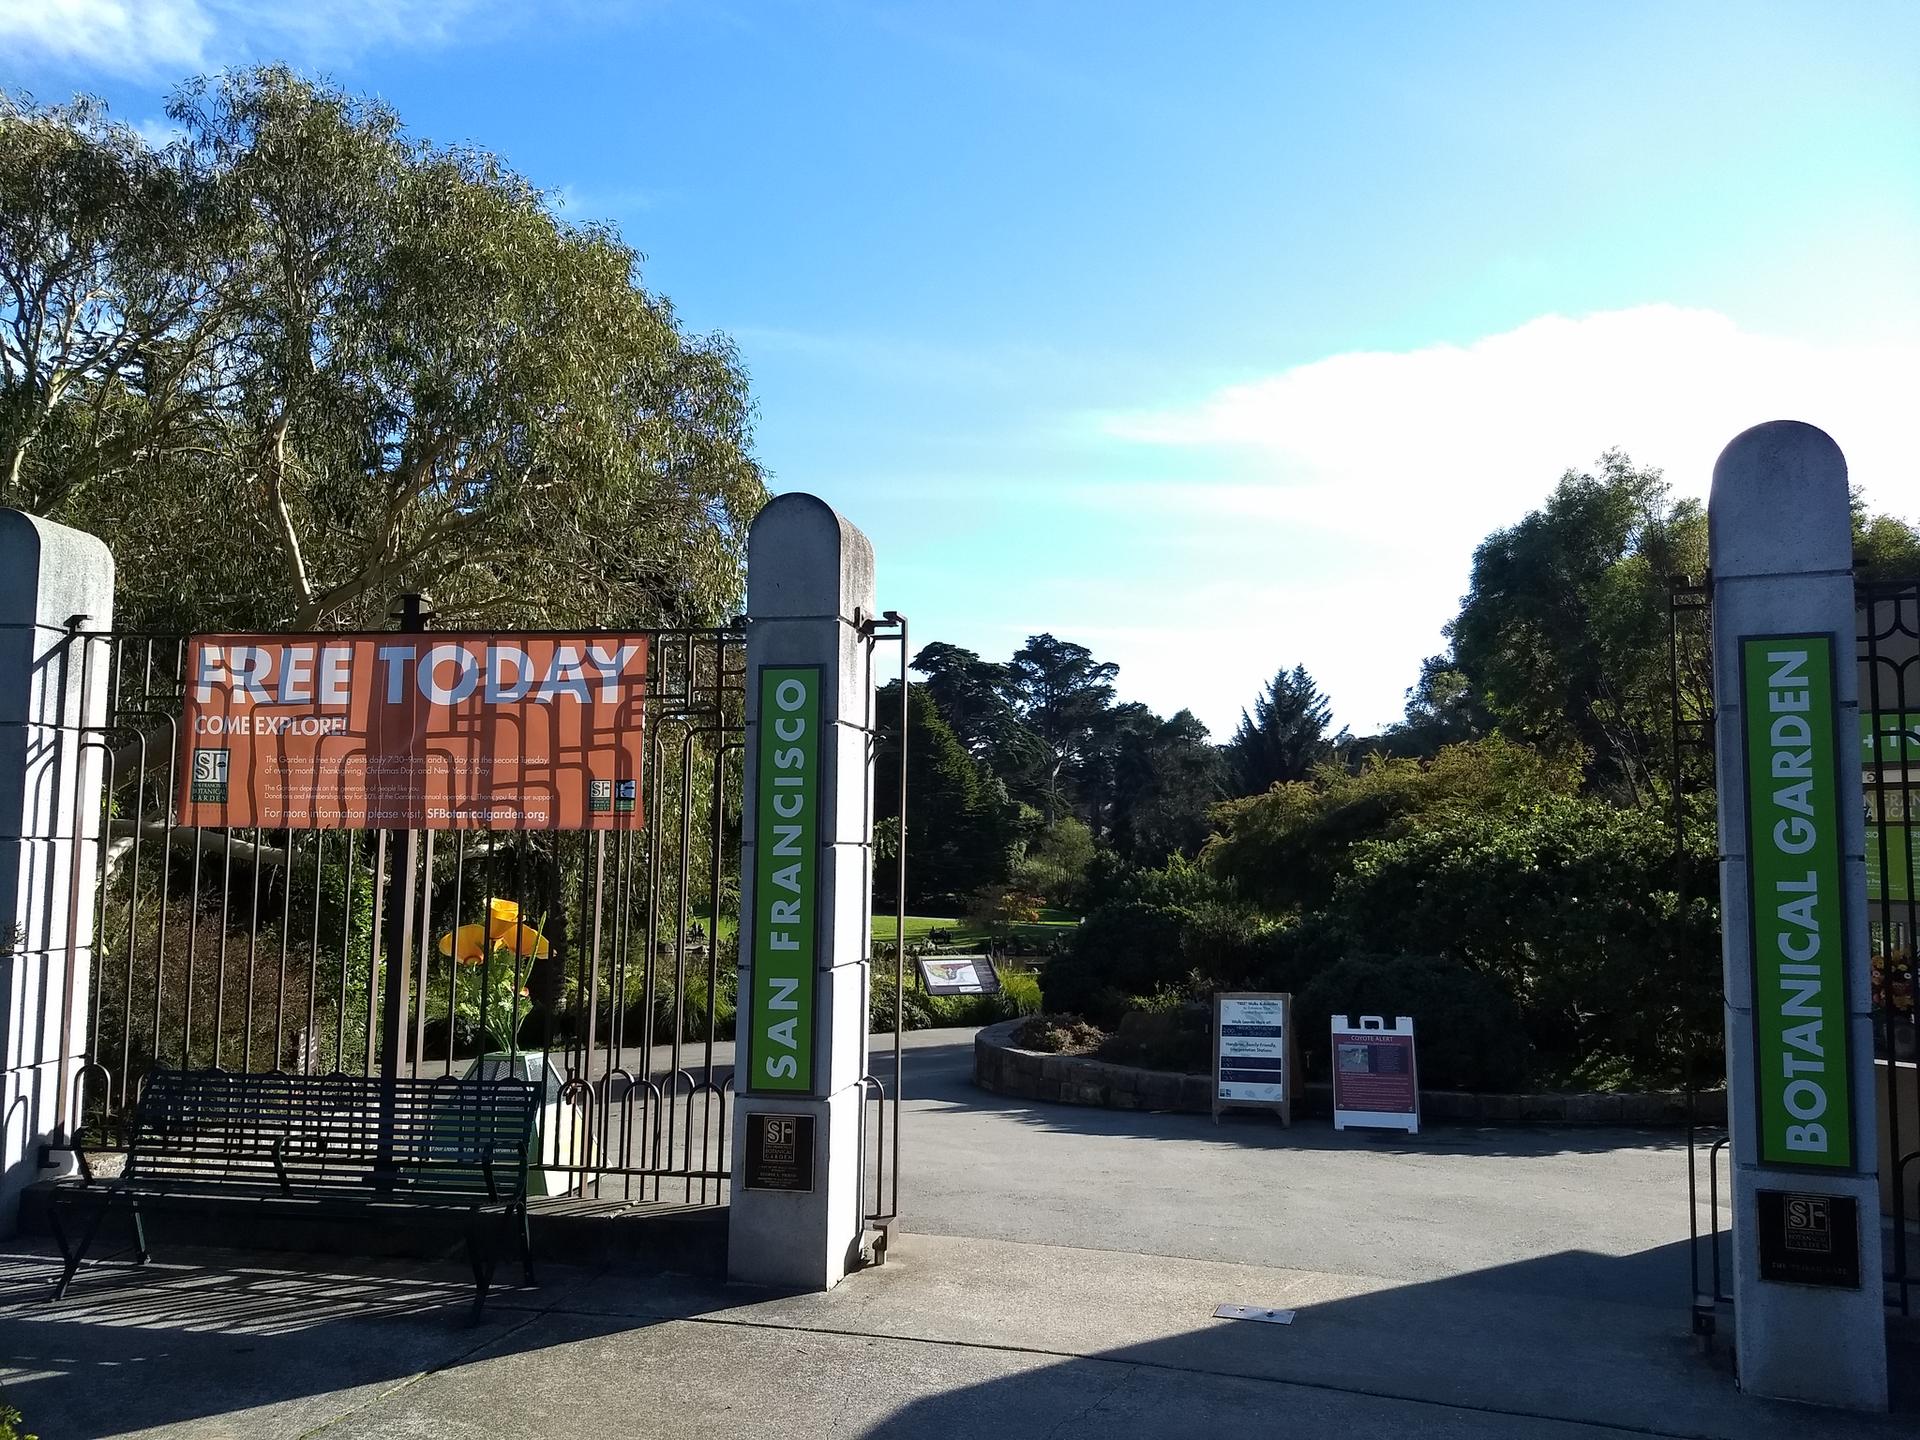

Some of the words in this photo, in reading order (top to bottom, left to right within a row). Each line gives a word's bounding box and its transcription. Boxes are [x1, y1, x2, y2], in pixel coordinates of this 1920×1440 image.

[197, 647, 352, 704] FREE
[379, 644, 639, 705] TODAY
[195, 715, 249, 735] COME
[255, 716, 347, 736] EXPLORE!
[195, 752, 227, 780] SF
[266, 755, 278, 763] The
[279, 755, 307, 764] Garden
[427, 755, 442, 763] and
[455, 756, 467, 765] day
[494, 755, 518, 763] second
[1767, 651, 1817, 855] GARDEN
[264, 808, 280, 818] For
[283, 810, 307, 818] more
[310, 807, 365, 818] information
[368, 807, 399, 820] please
[770, 678, 807, 951] FRANCISCO
[1776, 870, 1828, 1152] BOTANICAL
[766, 977, 799, 1079] SAN
[767, 1121, 792, 1143] SF
[1790, 1200, 1826, 1228] SF
